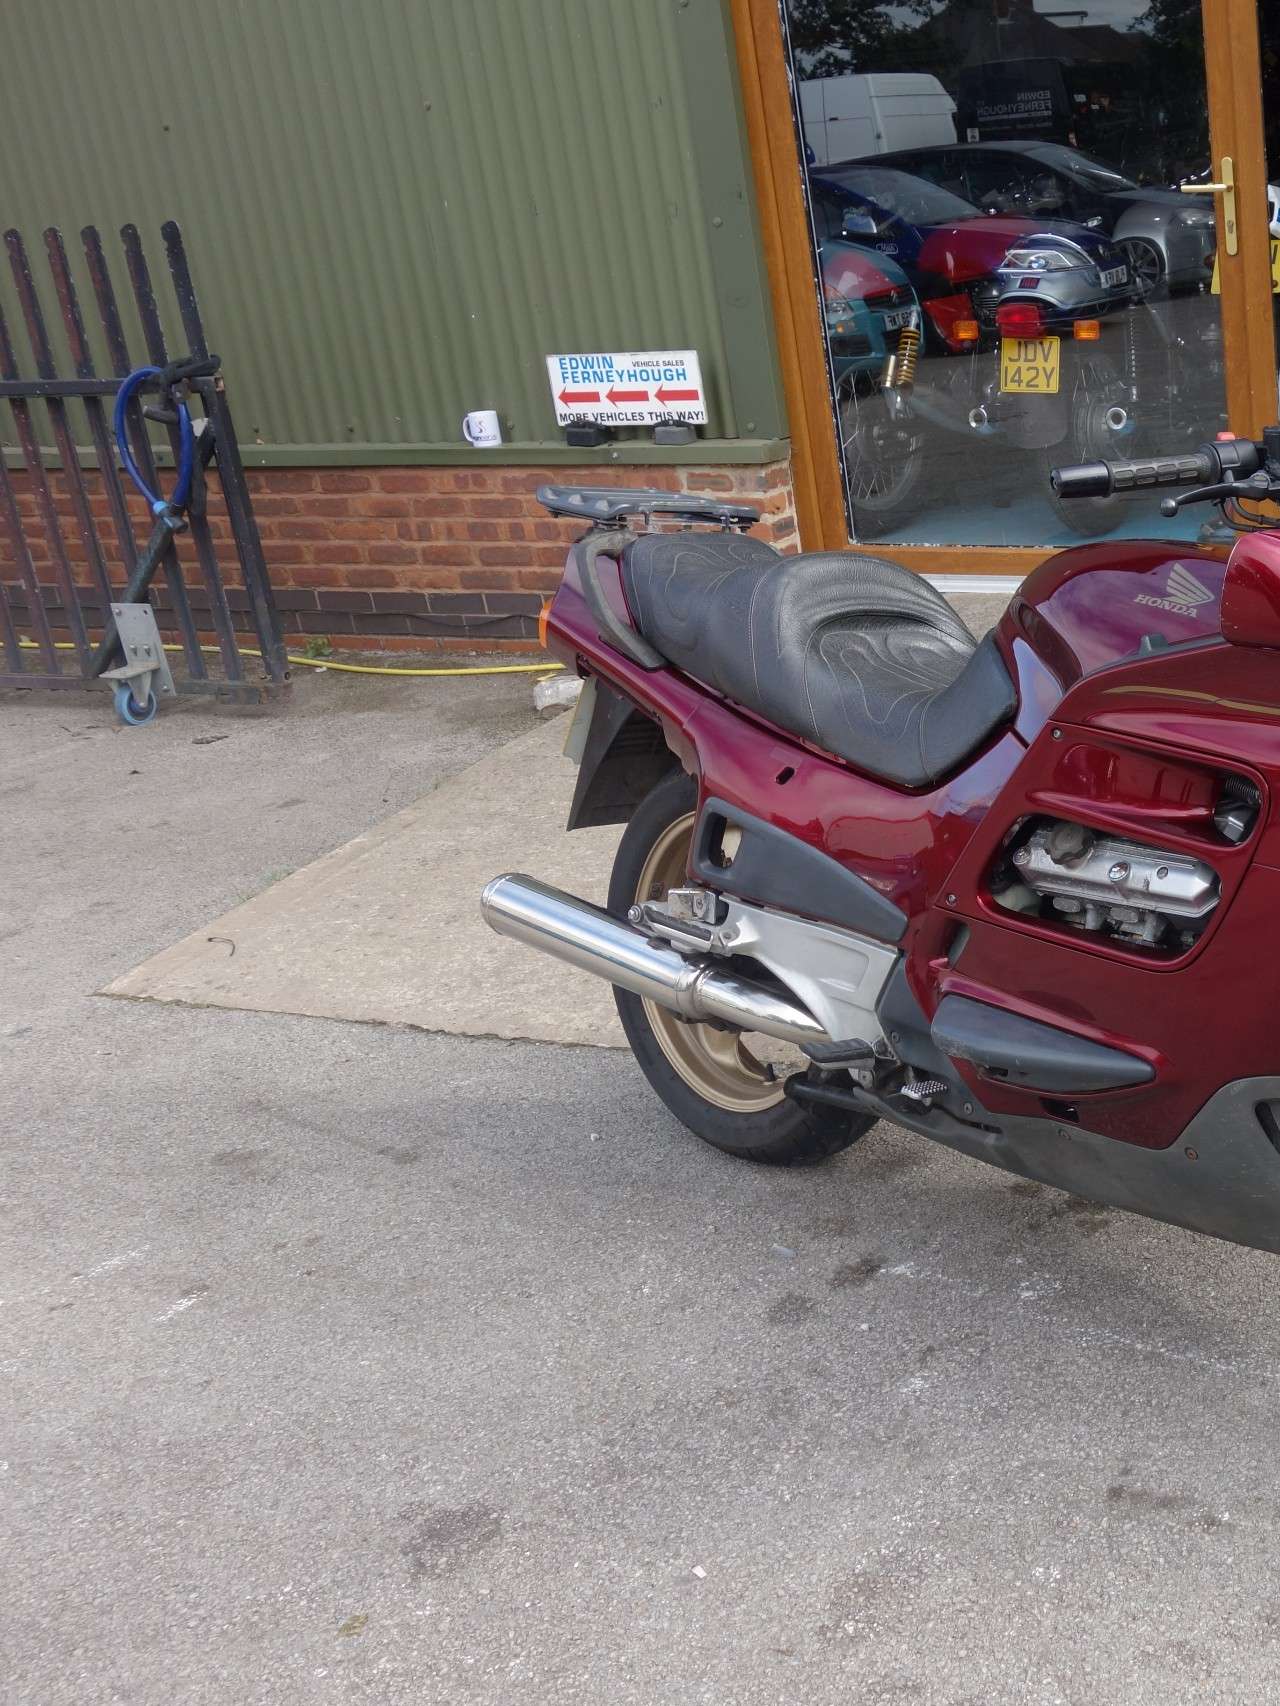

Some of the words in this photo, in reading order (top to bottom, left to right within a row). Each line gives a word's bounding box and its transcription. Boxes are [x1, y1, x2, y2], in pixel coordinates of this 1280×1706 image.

[1008, 341, 1053, 363] JDV
[559, 355, 614, 370] EDWIN
[632, 360, 660, 368] VEHICLE
[662, 359, 685, 367] SALES
[561, 367, 687, 384] FERNEYHOUGH
[1004, 366, 1056, 389] 142Y
[592, 411, 645, 423] VEHICLES
[648, 411, 673, 422] THIS
[676, 410, 704, 421] WAY!
[1133, 594, 1198, 618] HONDA
